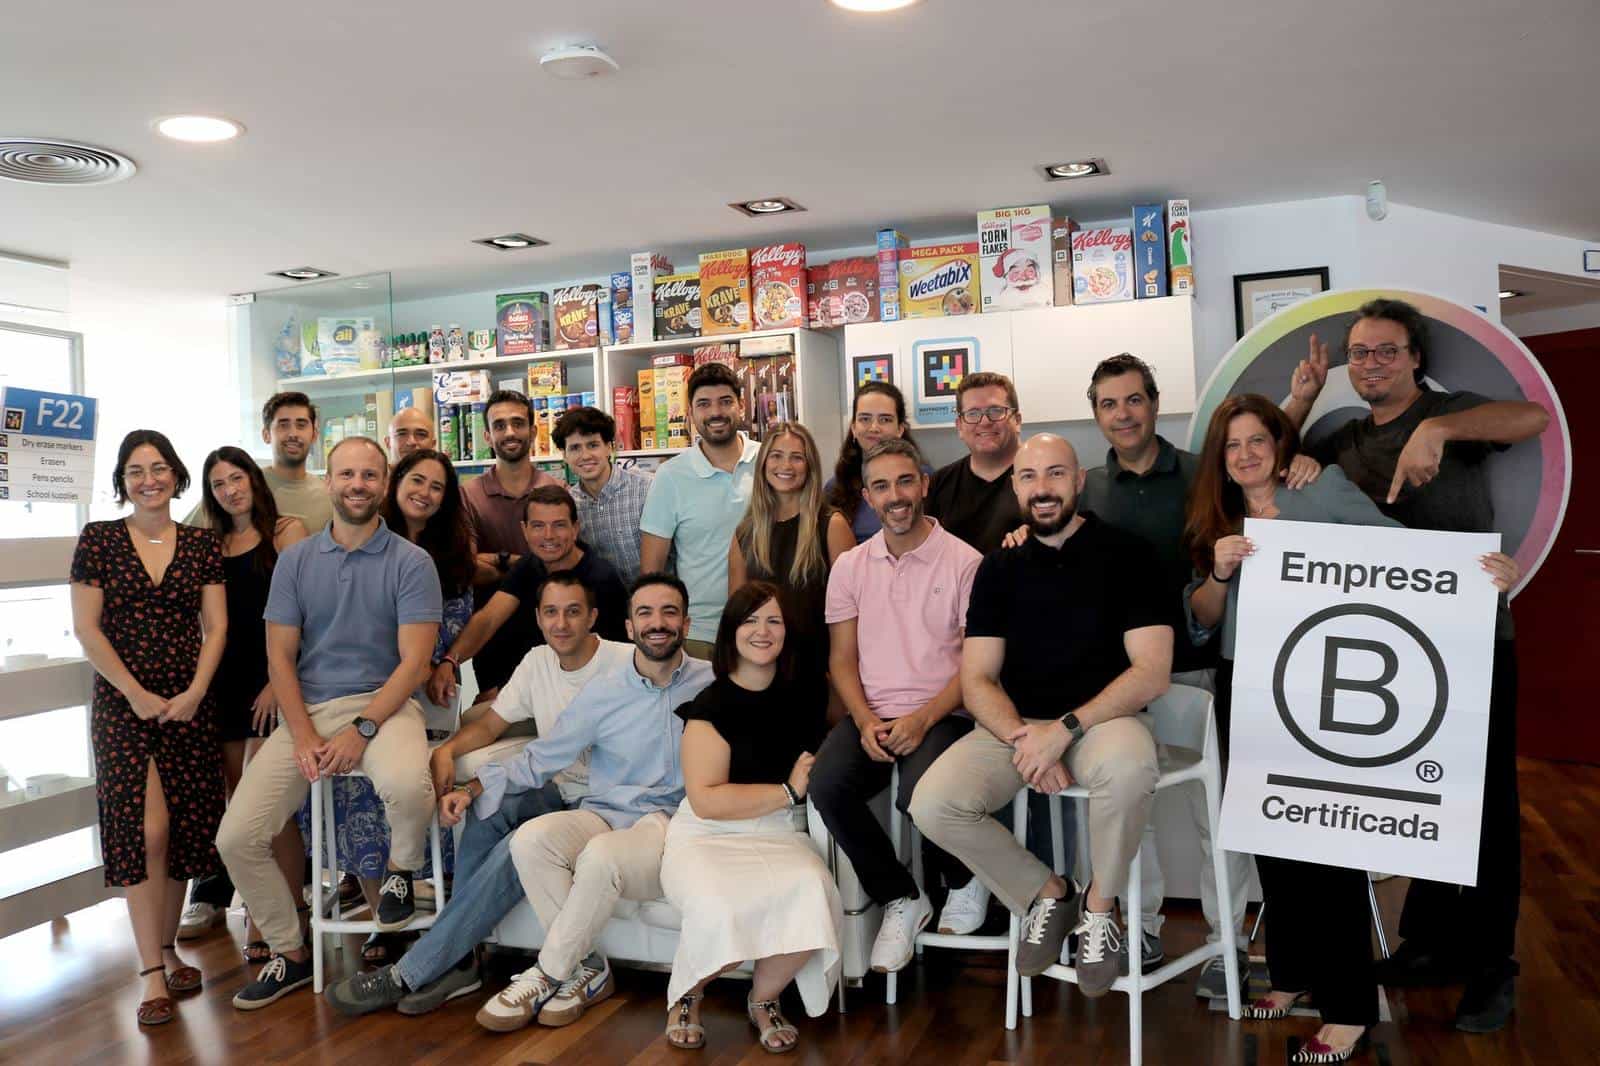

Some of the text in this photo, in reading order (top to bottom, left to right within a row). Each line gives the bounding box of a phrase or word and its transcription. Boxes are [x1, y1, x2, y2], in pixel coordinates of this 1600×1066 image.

[995, 208, 1031, 218] BIG 1KG
[981, 229, 1008, 244] CORN
[911, 246, 965, 258] MEGA PACK
[982, 242, 1009, 255] FLAKES
[910, 263, 972, 298] Weetabix
[705, 287, 740, 309] KRAVE
[560, 308, 588, 327] KRAVE
[664, 302, 691, 319] KRAVE
[335, 328, 352, 342] all
[36, 398, 84, 430] F22
[22, 438, 34, 449] Dry
[56, 442, 83, 451] markers
[40, 456, 66, 467] Erasers
[32, 473, 74, 484] Pens pencils
[26, 489, 79, 501] School supplies
[1280, 551, 1458, 595] Empresa
[1319, 635, 1400, 736] B
[1261, 795, 1440, 841] Certificada
